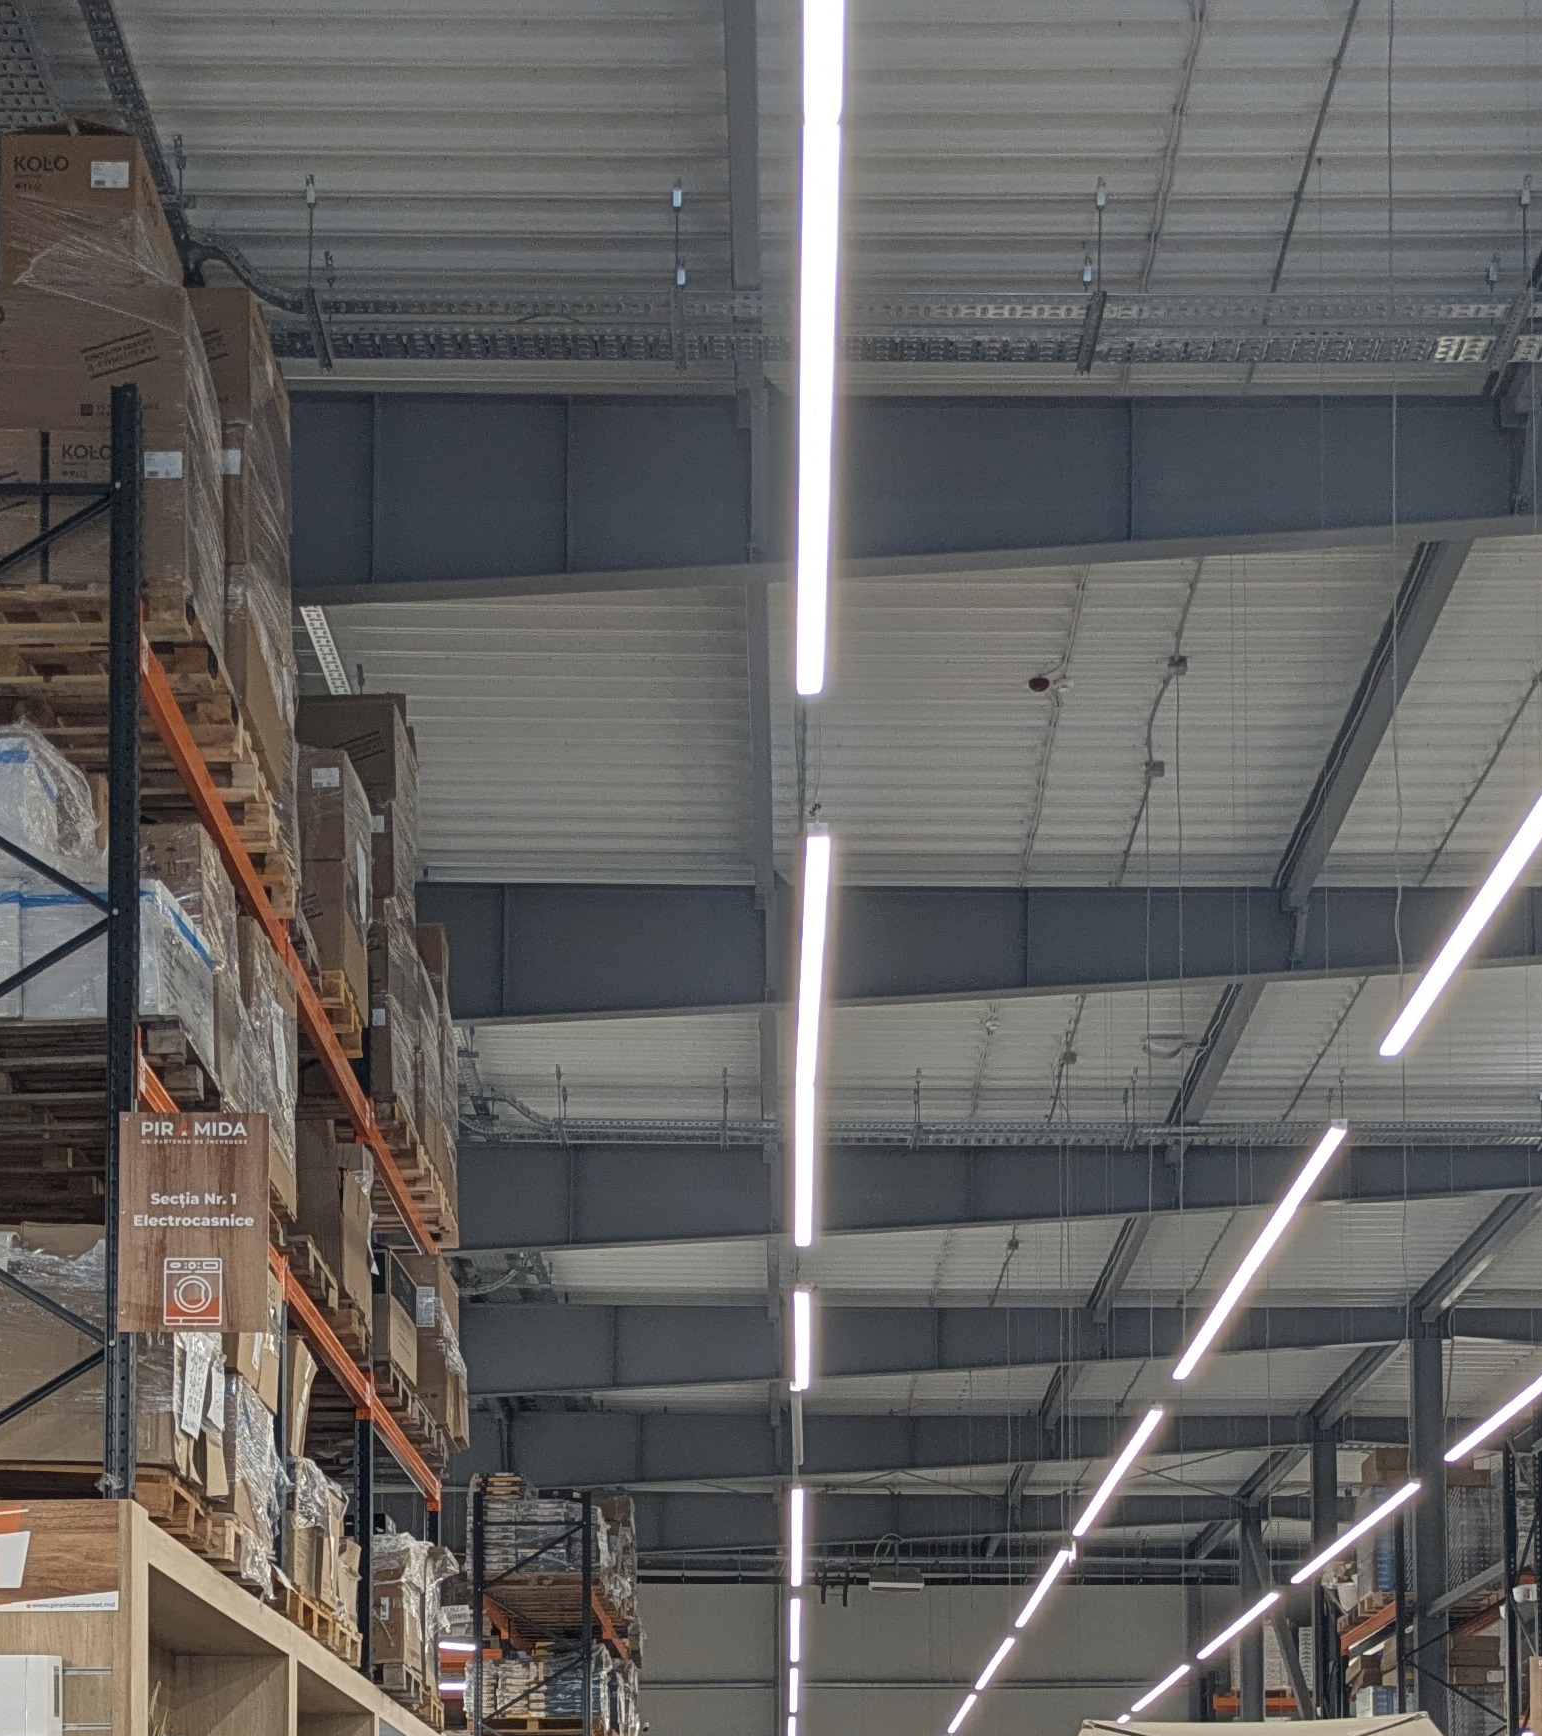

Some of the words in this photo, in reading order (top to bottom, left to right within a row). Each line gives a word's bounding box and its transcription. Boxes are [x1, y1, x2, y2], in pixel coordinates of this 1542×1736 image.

[13, 155, 70, 174] KOŁO
[150, 1193, 200, 1209] Secția
[204, 1193, 227, 1205] Nr.
[230, 1193, 237, 1205] 1
[133, 1213, 254, 1227] Electrocasnice
